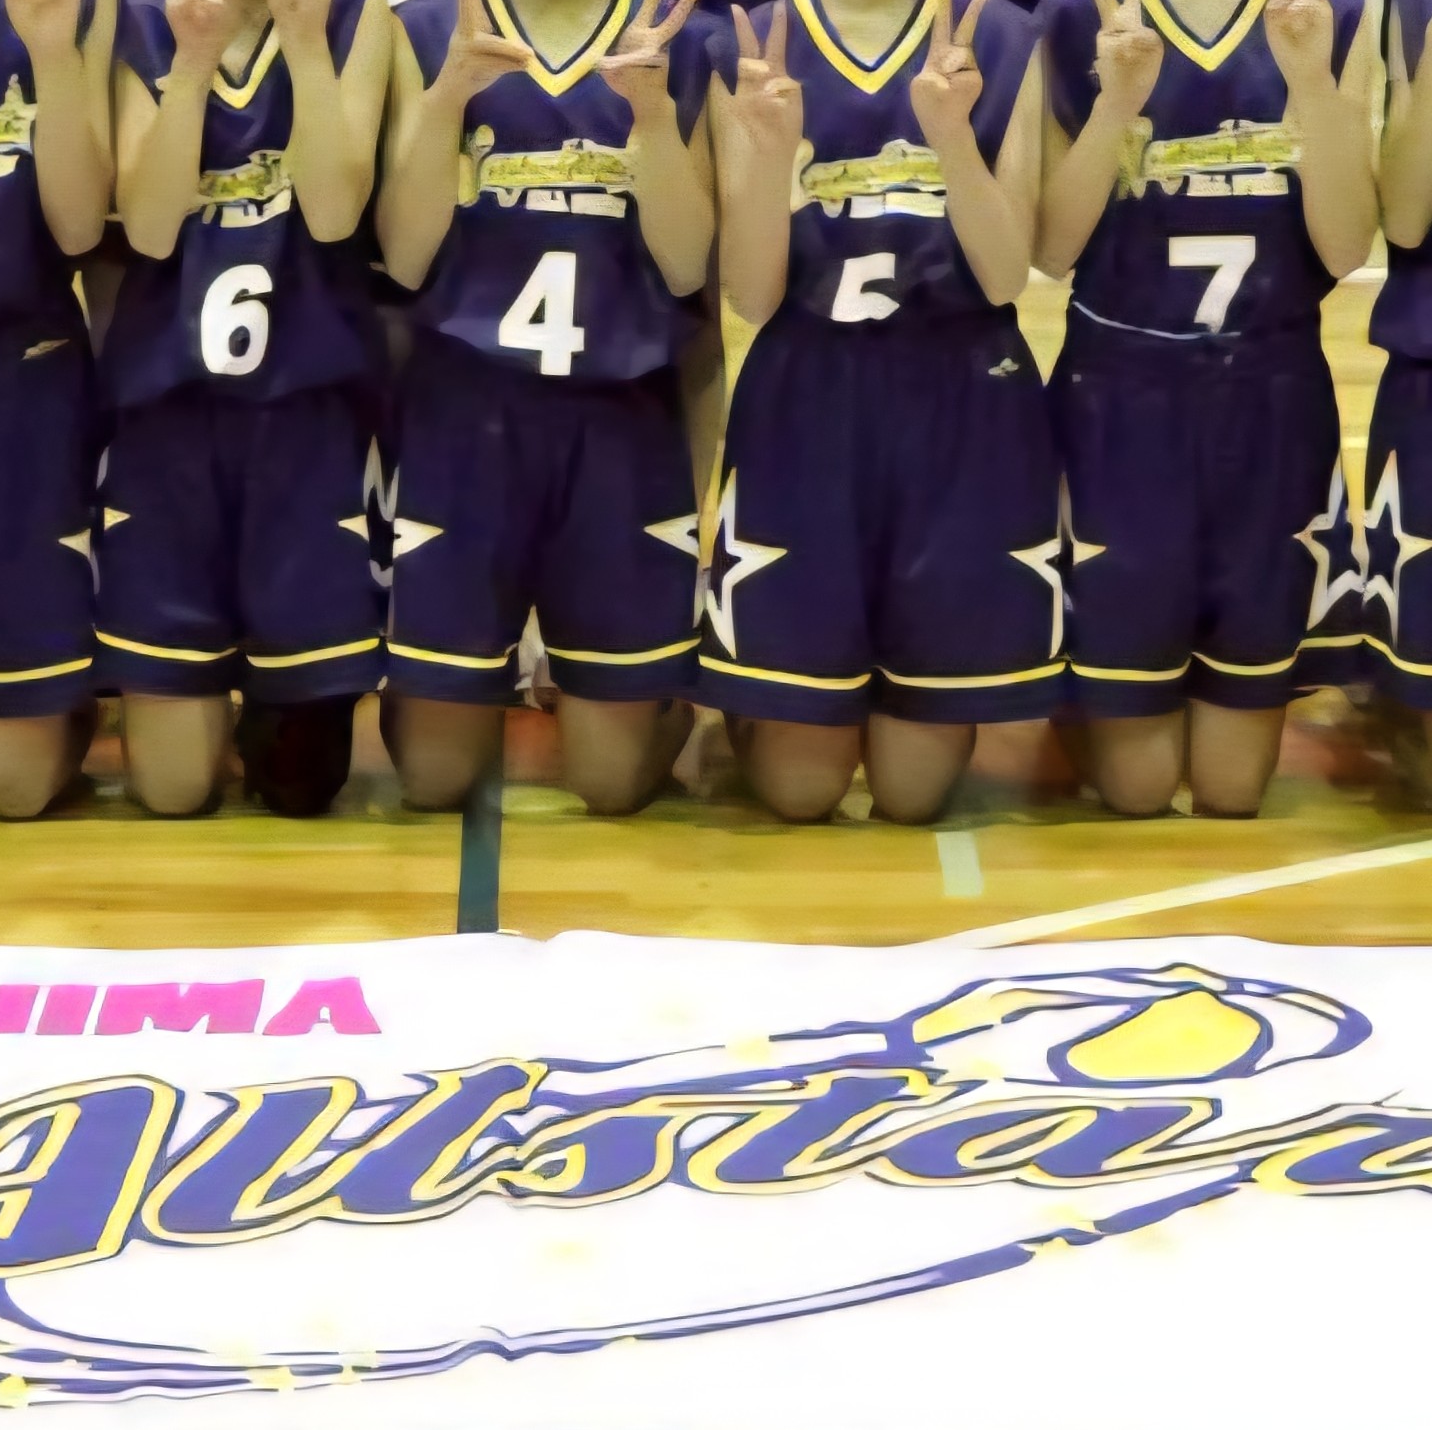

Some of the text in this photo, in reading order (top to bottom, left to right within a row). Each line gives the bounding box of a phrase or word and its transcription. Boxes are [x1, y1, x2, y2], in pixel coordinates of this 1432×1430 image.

[200, 264, 273, 376] 6
[497, 251, 585, 376] 4
[1168, 235, 1256, 335] 7
